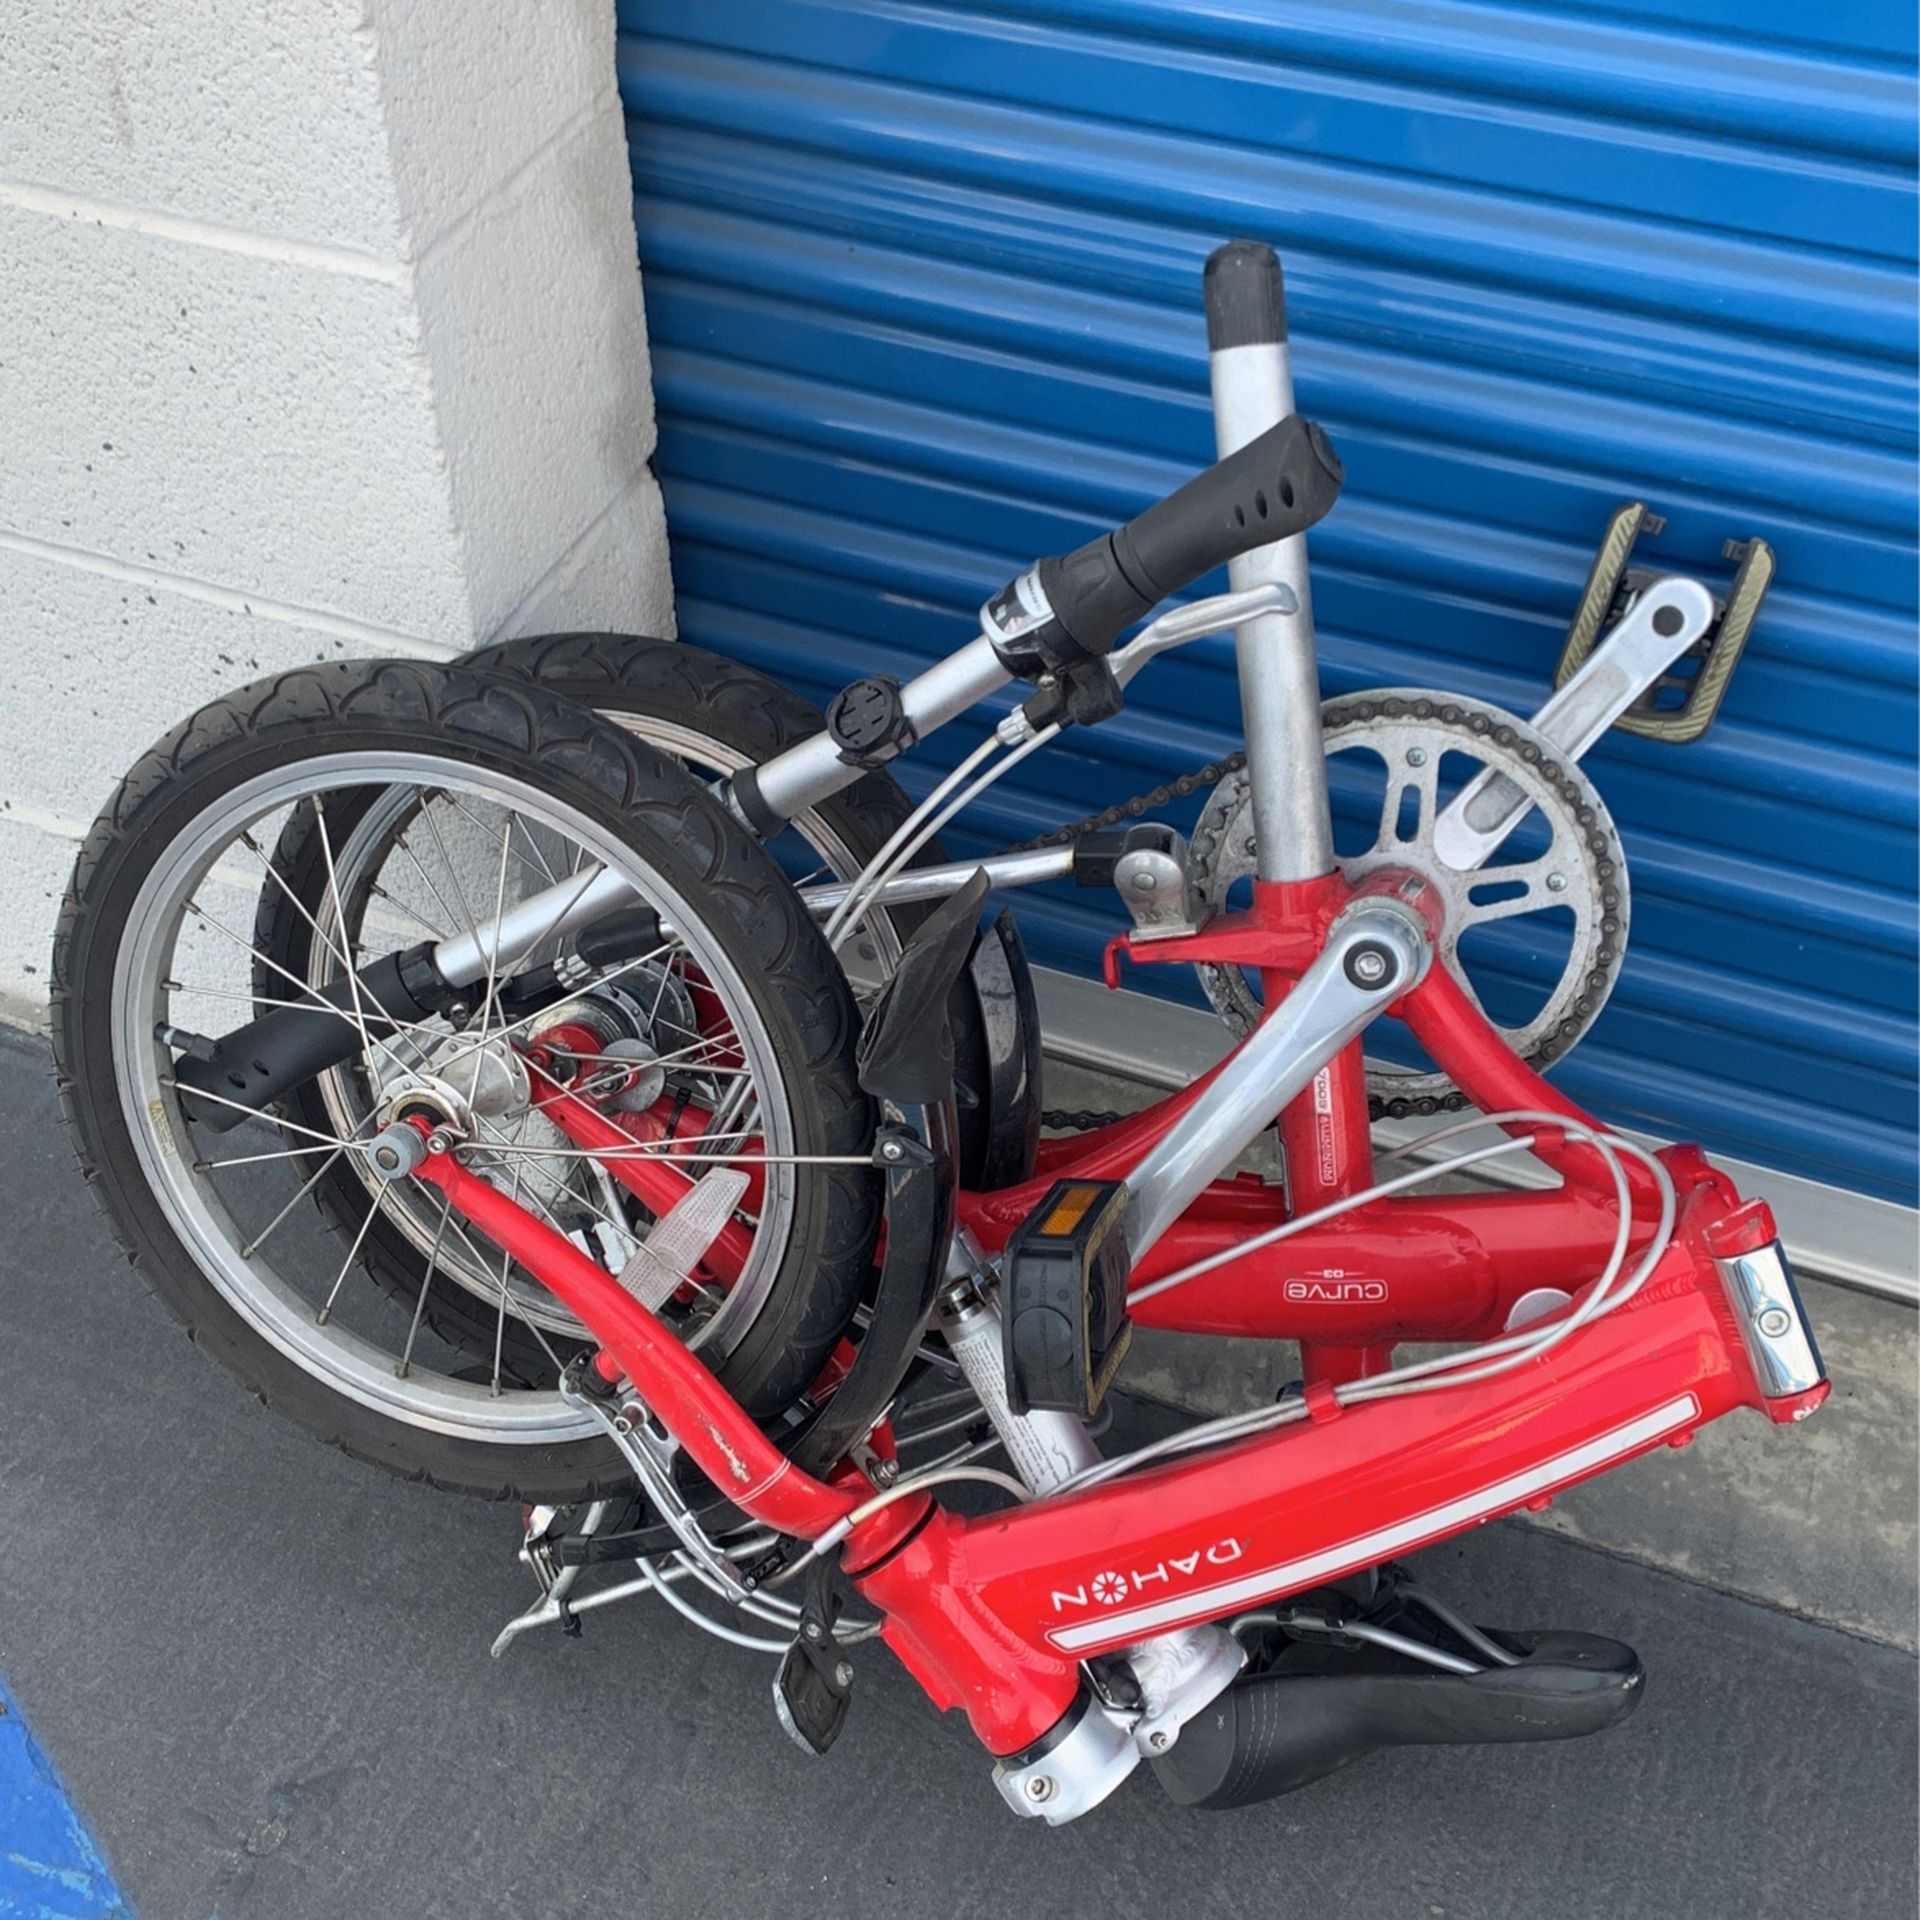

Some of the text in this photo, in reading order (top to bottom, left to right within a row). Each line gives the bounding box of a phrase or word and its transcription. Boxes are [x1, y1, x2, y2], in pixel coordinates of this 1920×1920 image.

[1319, 1115, 1333, 1182] ALUMINUM
[1287, 1282, 1384, 1300] curve
[1051, 1537, 1242, 1611] DAHON
